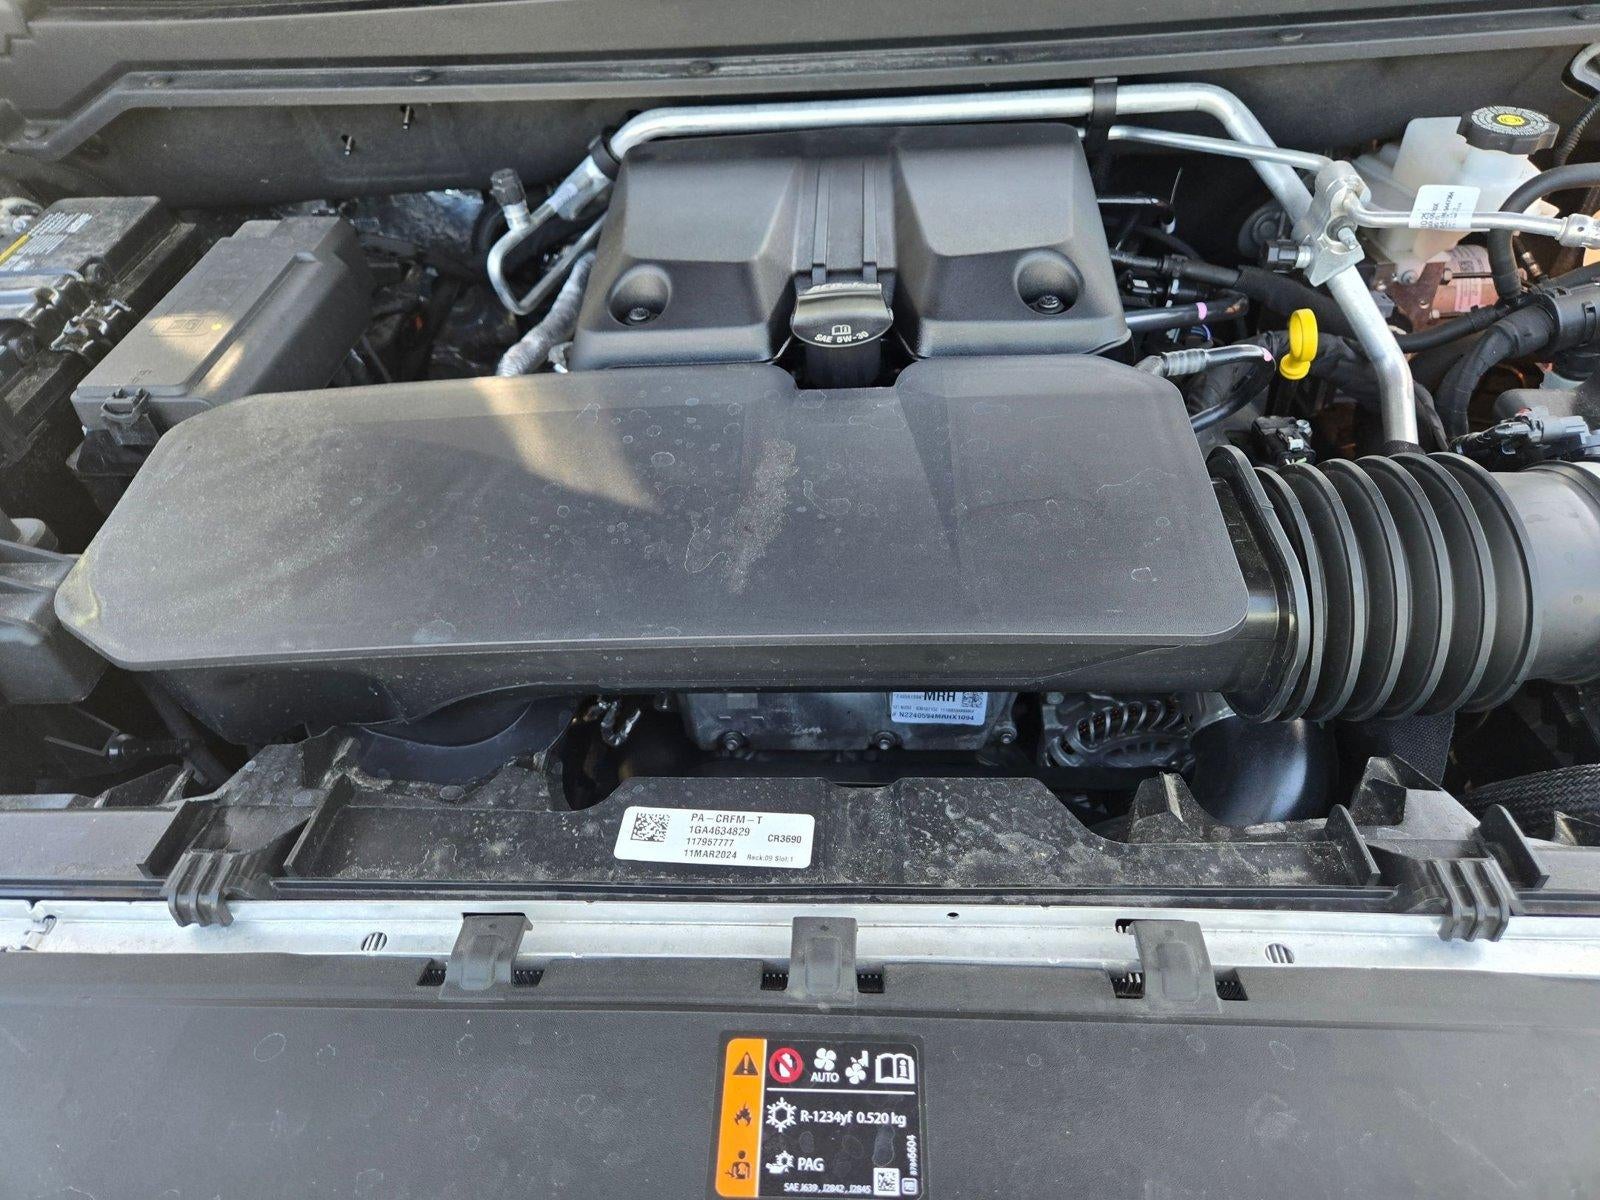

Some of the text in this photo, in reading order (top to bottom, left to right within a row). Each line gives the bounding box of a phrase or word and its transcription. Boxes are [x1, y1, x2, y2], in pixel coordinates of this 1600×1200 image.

[814, 333, 833, 343] SAE
[924, 692, 956, 702] MRH
[689, 825, 751, 837] 1GA4634829
[686, 837, 735, 847] 117957777
[767, 834, 802, 844] CR3690
[683, 849, 737, 860] 11MAR2024
[810, 1072, 840, 1083] AUTO
[800, 1110, 907, 1127] R-1234yf 0.520 kg
[797, 1157, 825, 1171] PAG
[783, 1182, 800, 1192] SAE
